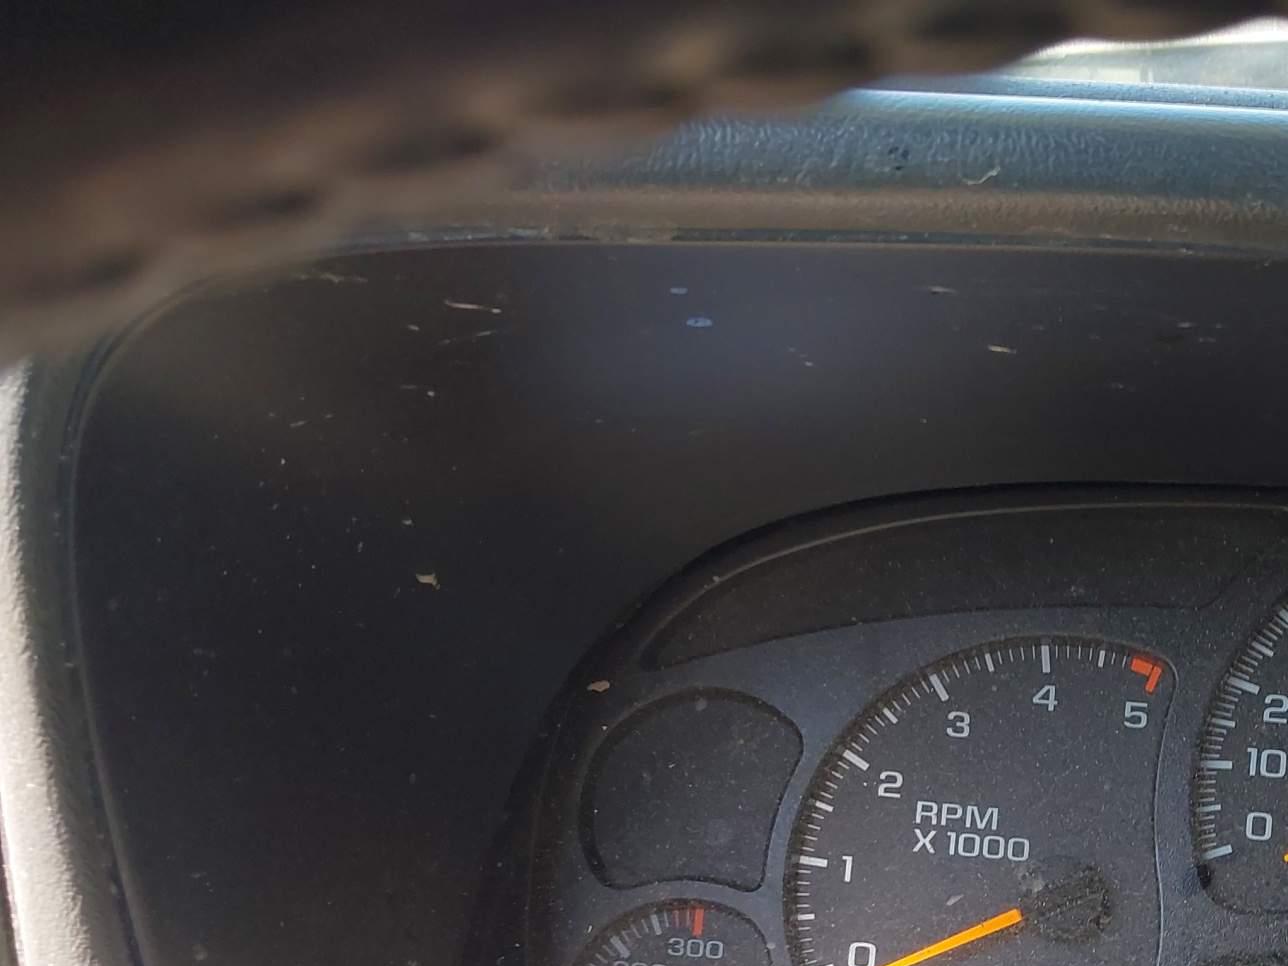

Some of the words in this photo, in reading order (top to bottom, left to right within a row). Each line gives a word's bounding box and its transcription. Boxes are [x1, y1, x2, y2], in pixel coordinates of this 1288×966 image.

[1032, 684, 1058, 712] 4
[946, 710, 971, 739] 3
[1123, 700, 1149, 729] 5
[1246, 746, 1287, 779] 10
[878, 770, 904, 799] 2
[915, 800, 1000, 831] RPM
[1246, 811, 1273, 841] 0
[912, 828, 937, 856] X
[946, 830, 1031, 862] 1000
[841, 855, 854, 883] 1
[667, 937, 725, 960] 300
